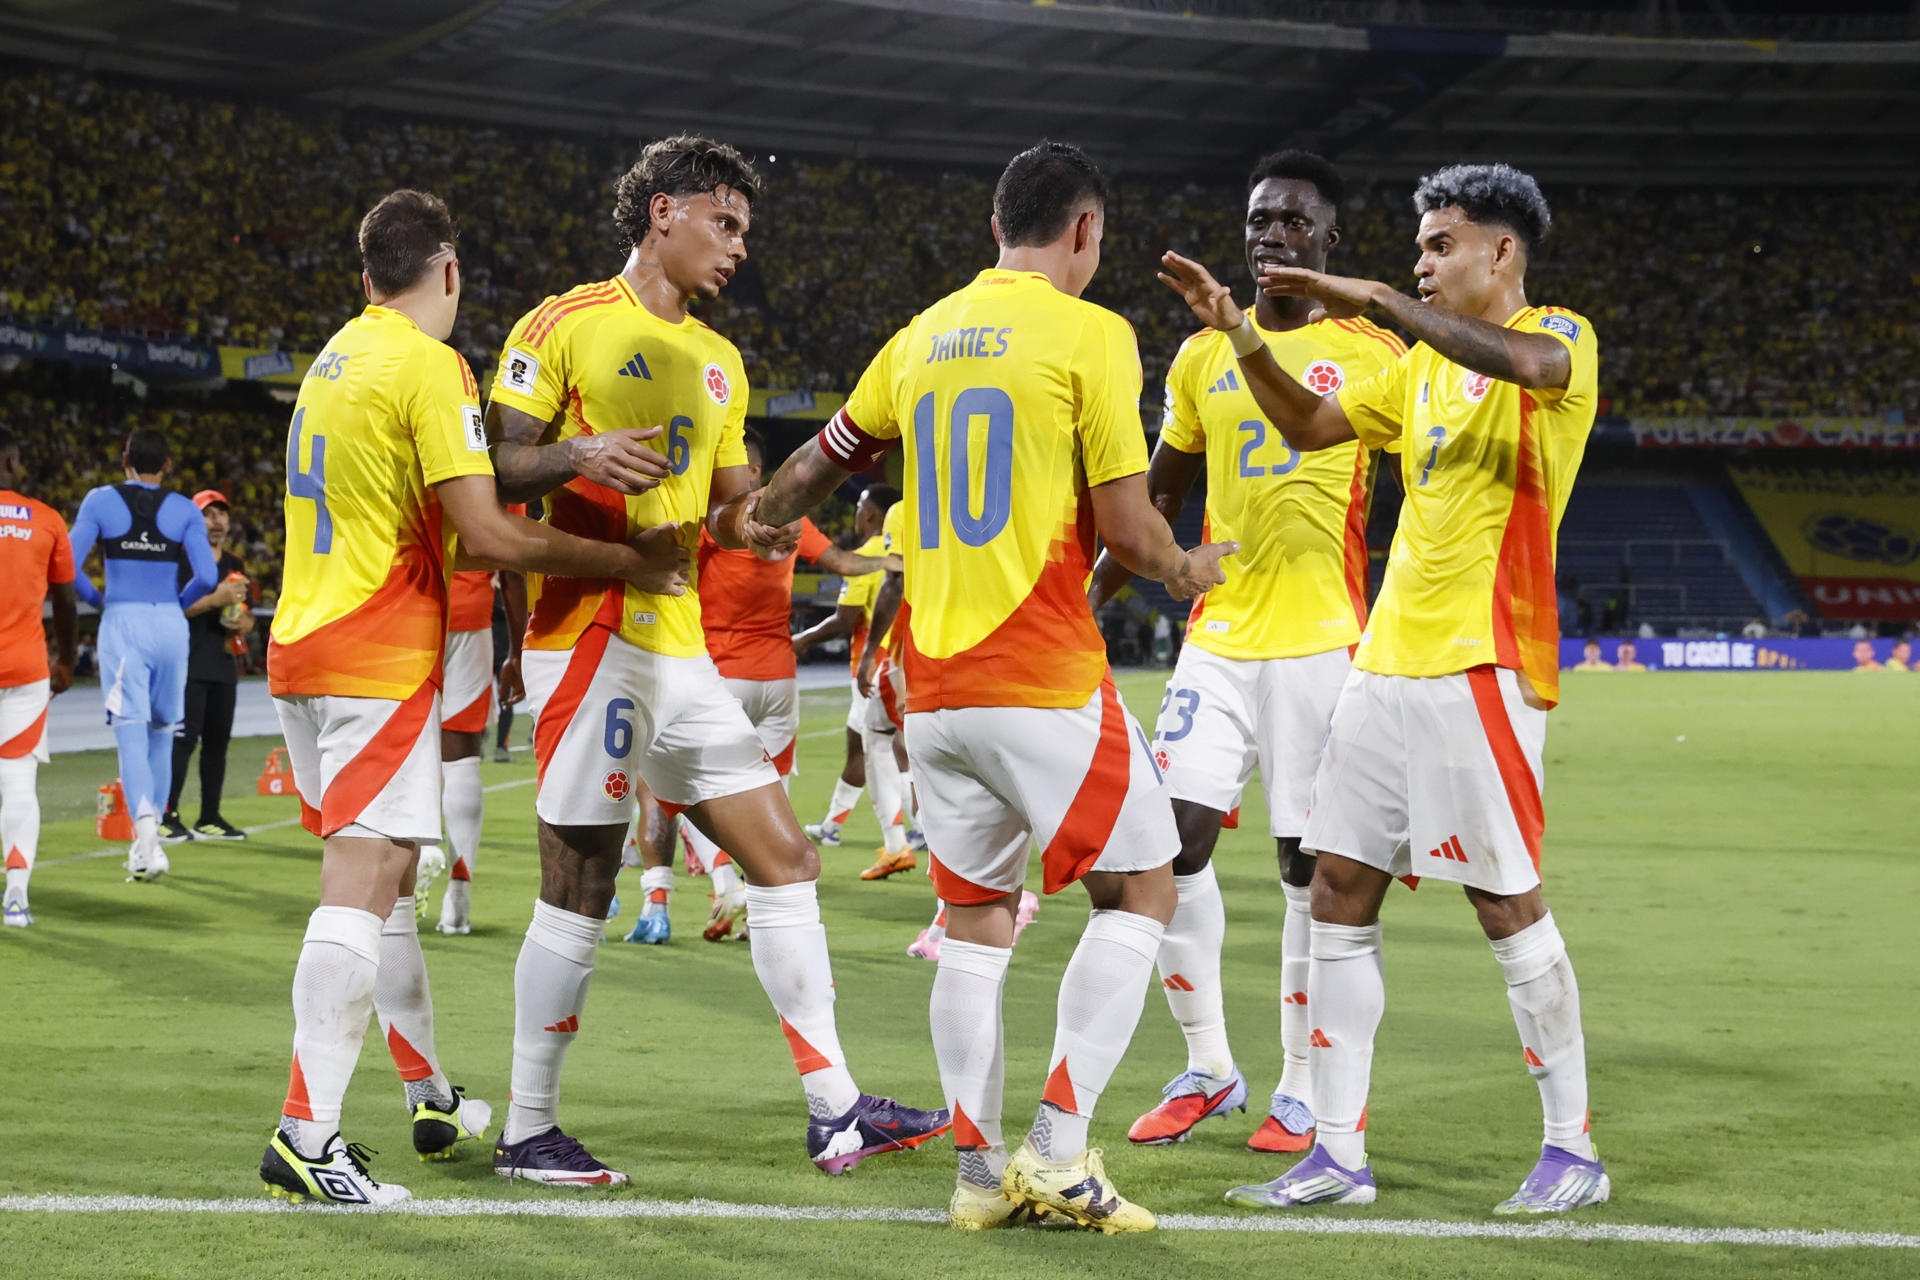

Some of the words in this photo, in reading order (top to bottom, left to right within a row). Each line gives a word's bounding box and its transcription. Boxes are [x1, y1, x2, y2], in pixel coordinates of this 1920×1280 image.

[926, 327, 1013, 364] JAMES
[667, 415, 694, 476] 6
[1630, 418, 1766, 445] FUERZA
[914, 387, 1014, 550] 10
[1418, 426, 1447, 486] 7
[287, 406, 333, 555] 4
[121, 541, 167, 553] CATAPULT
[1685, 641, 1731, 667] CASA
[604, 698, 634, 759] 6
[270, 779, 282, 794] G
